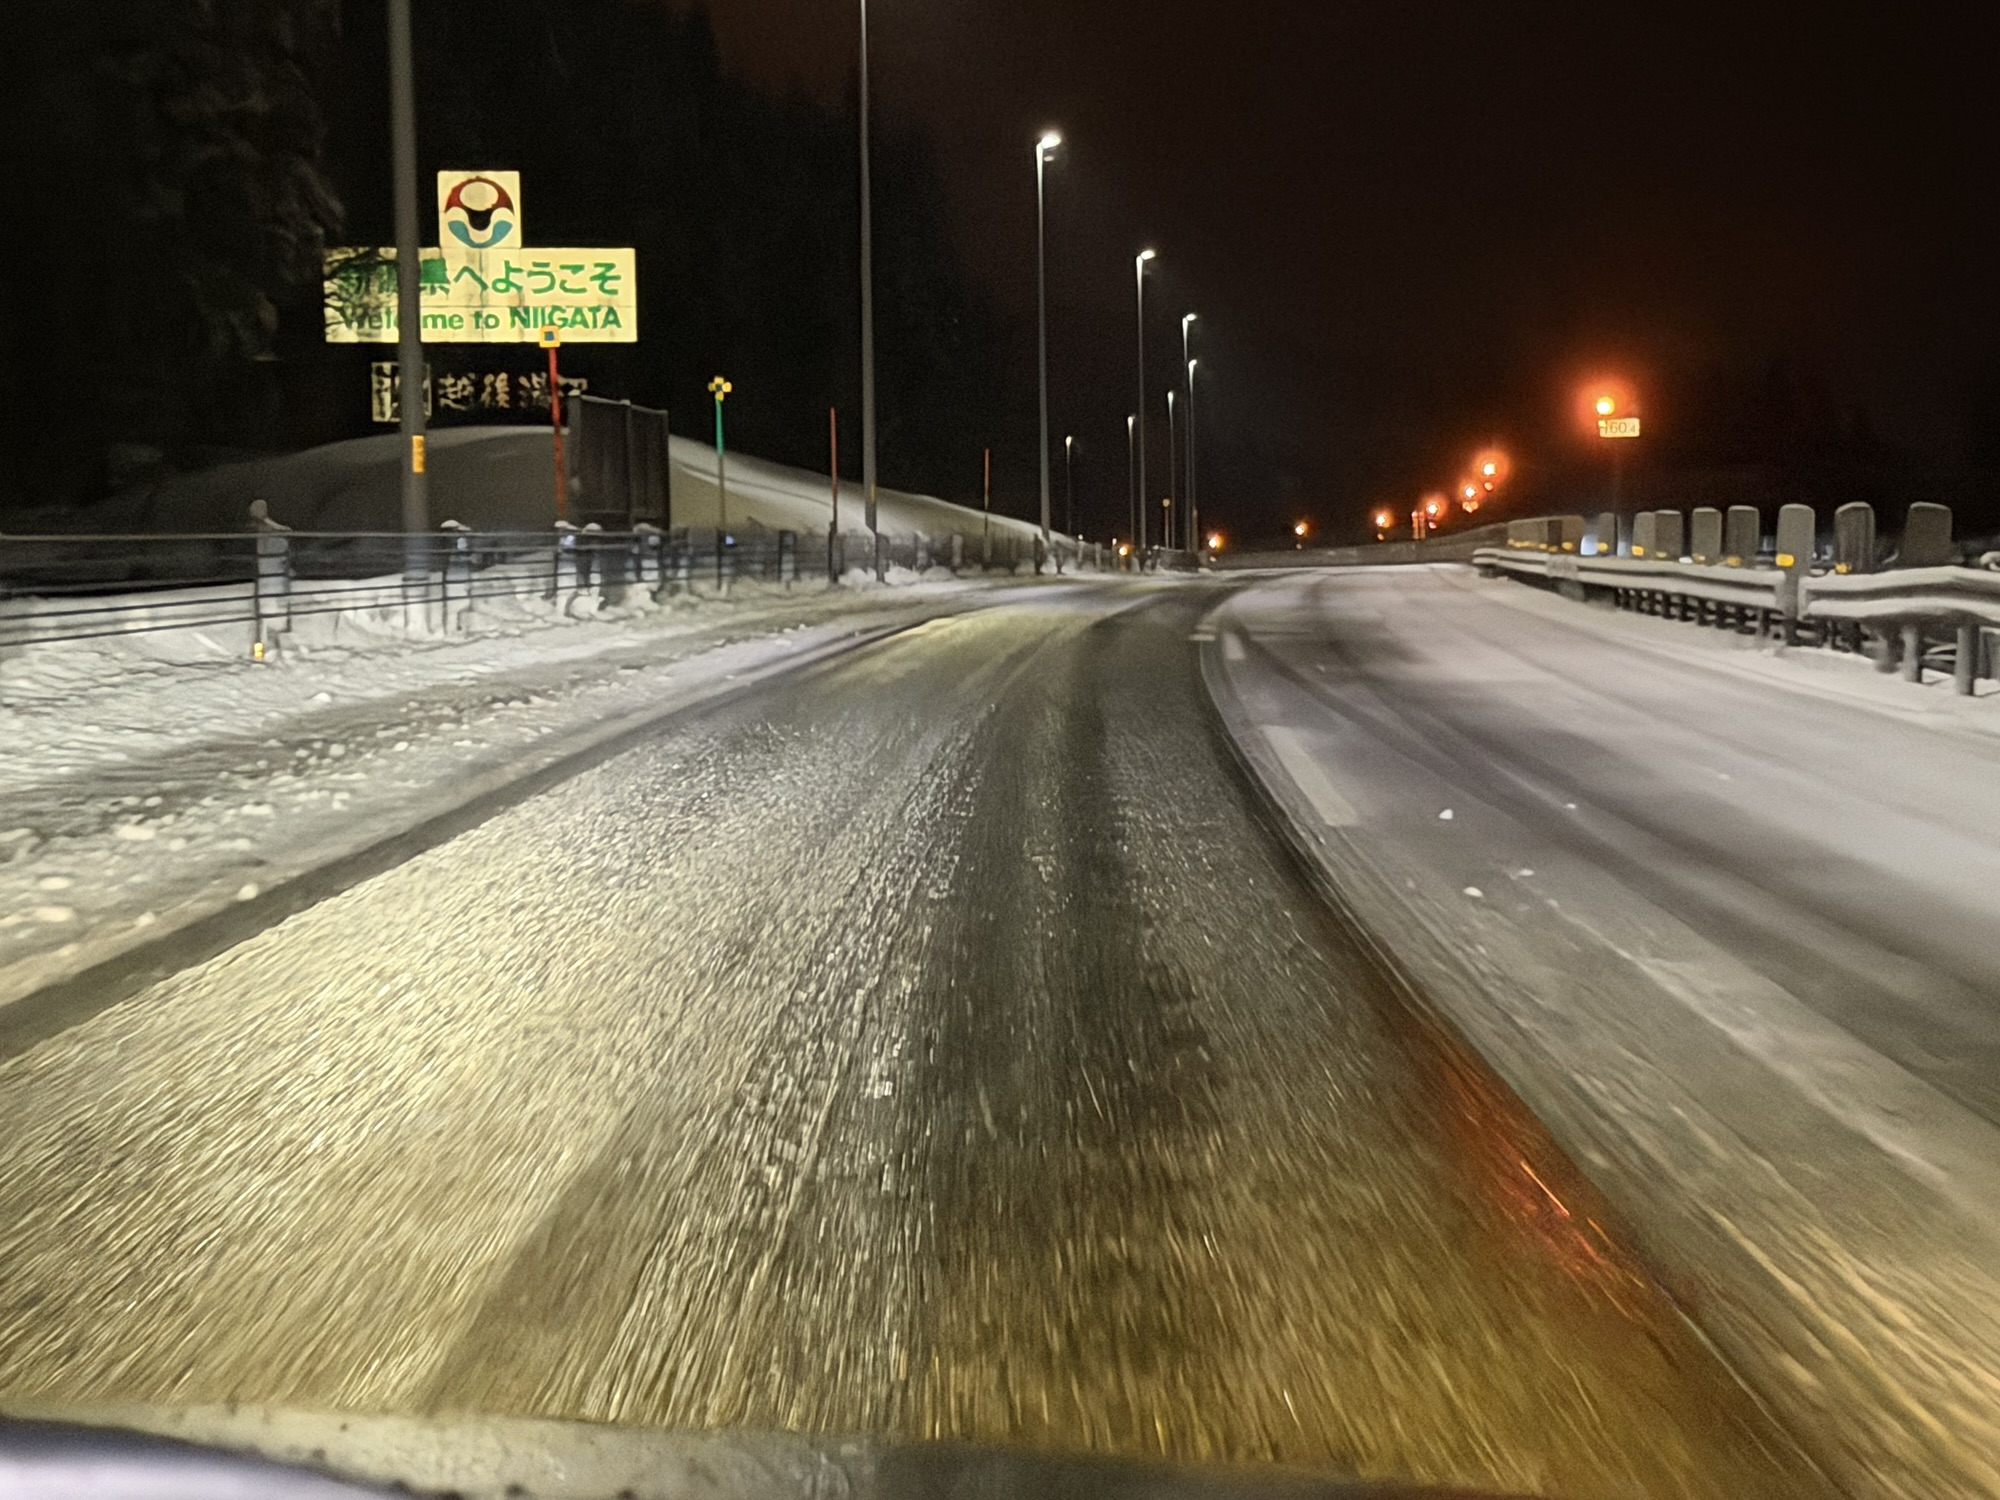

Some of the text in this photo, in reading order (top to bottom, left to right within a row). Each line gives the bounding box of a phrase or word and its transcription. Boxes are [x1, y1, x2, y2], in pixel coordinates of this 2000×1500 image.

[343, 303, 622, 330] Welme to NIIGATA
